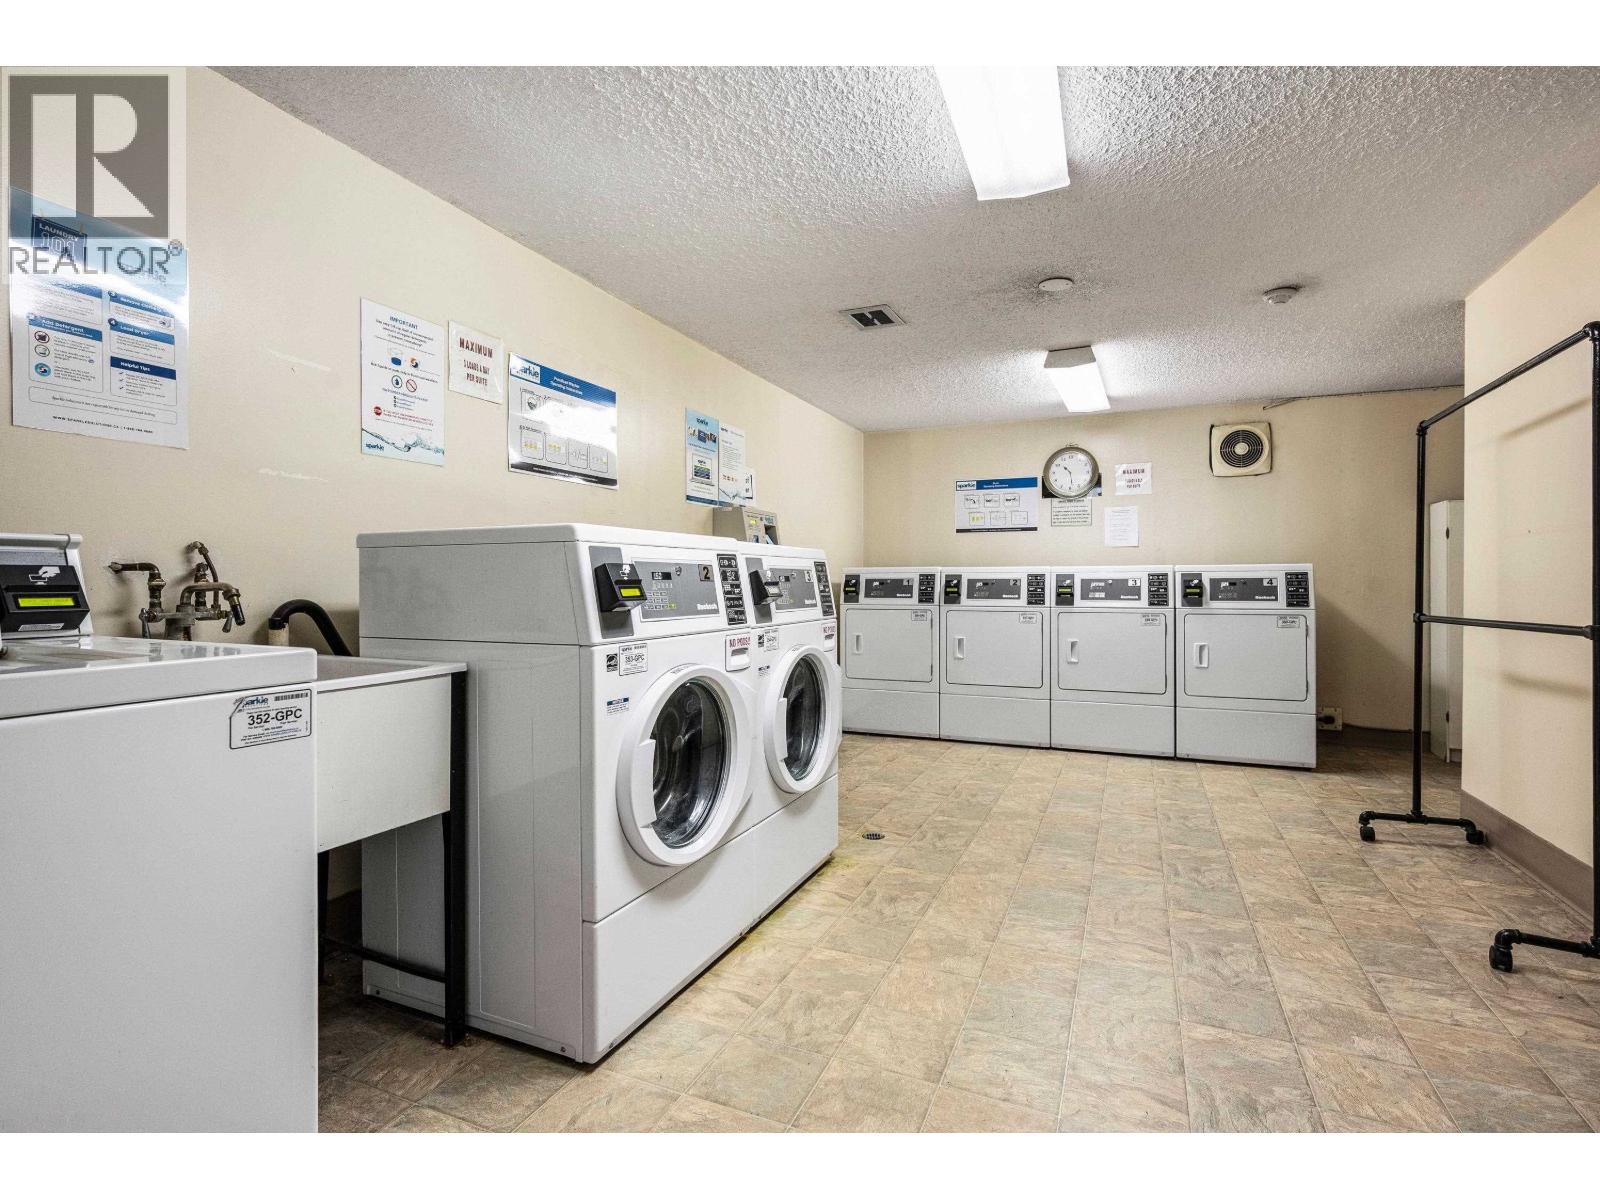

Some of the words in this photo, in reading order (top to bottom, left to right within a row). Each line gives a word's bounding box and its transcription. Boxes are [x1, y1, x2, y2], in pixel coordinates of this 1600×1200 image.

[42, 318, 54, 327] Add
[55, 320, 85, 333] Detergent
[389, 315, 419, 331] IMPORTANT
[459, 337, 493, 359] MAXIMUM
[120, 361, 139, 372] Helpful
[140, 365, 151, 373] Tips
[466, 372, 475, 381] PER
[475, 376, 488, 386] SUITE
[702, 566, 710, 580] 2
[1266, 578, 1274, 586] 4
[729, 638, 736, 648] NO
[248, 708, 302, 726] 352-GPC
